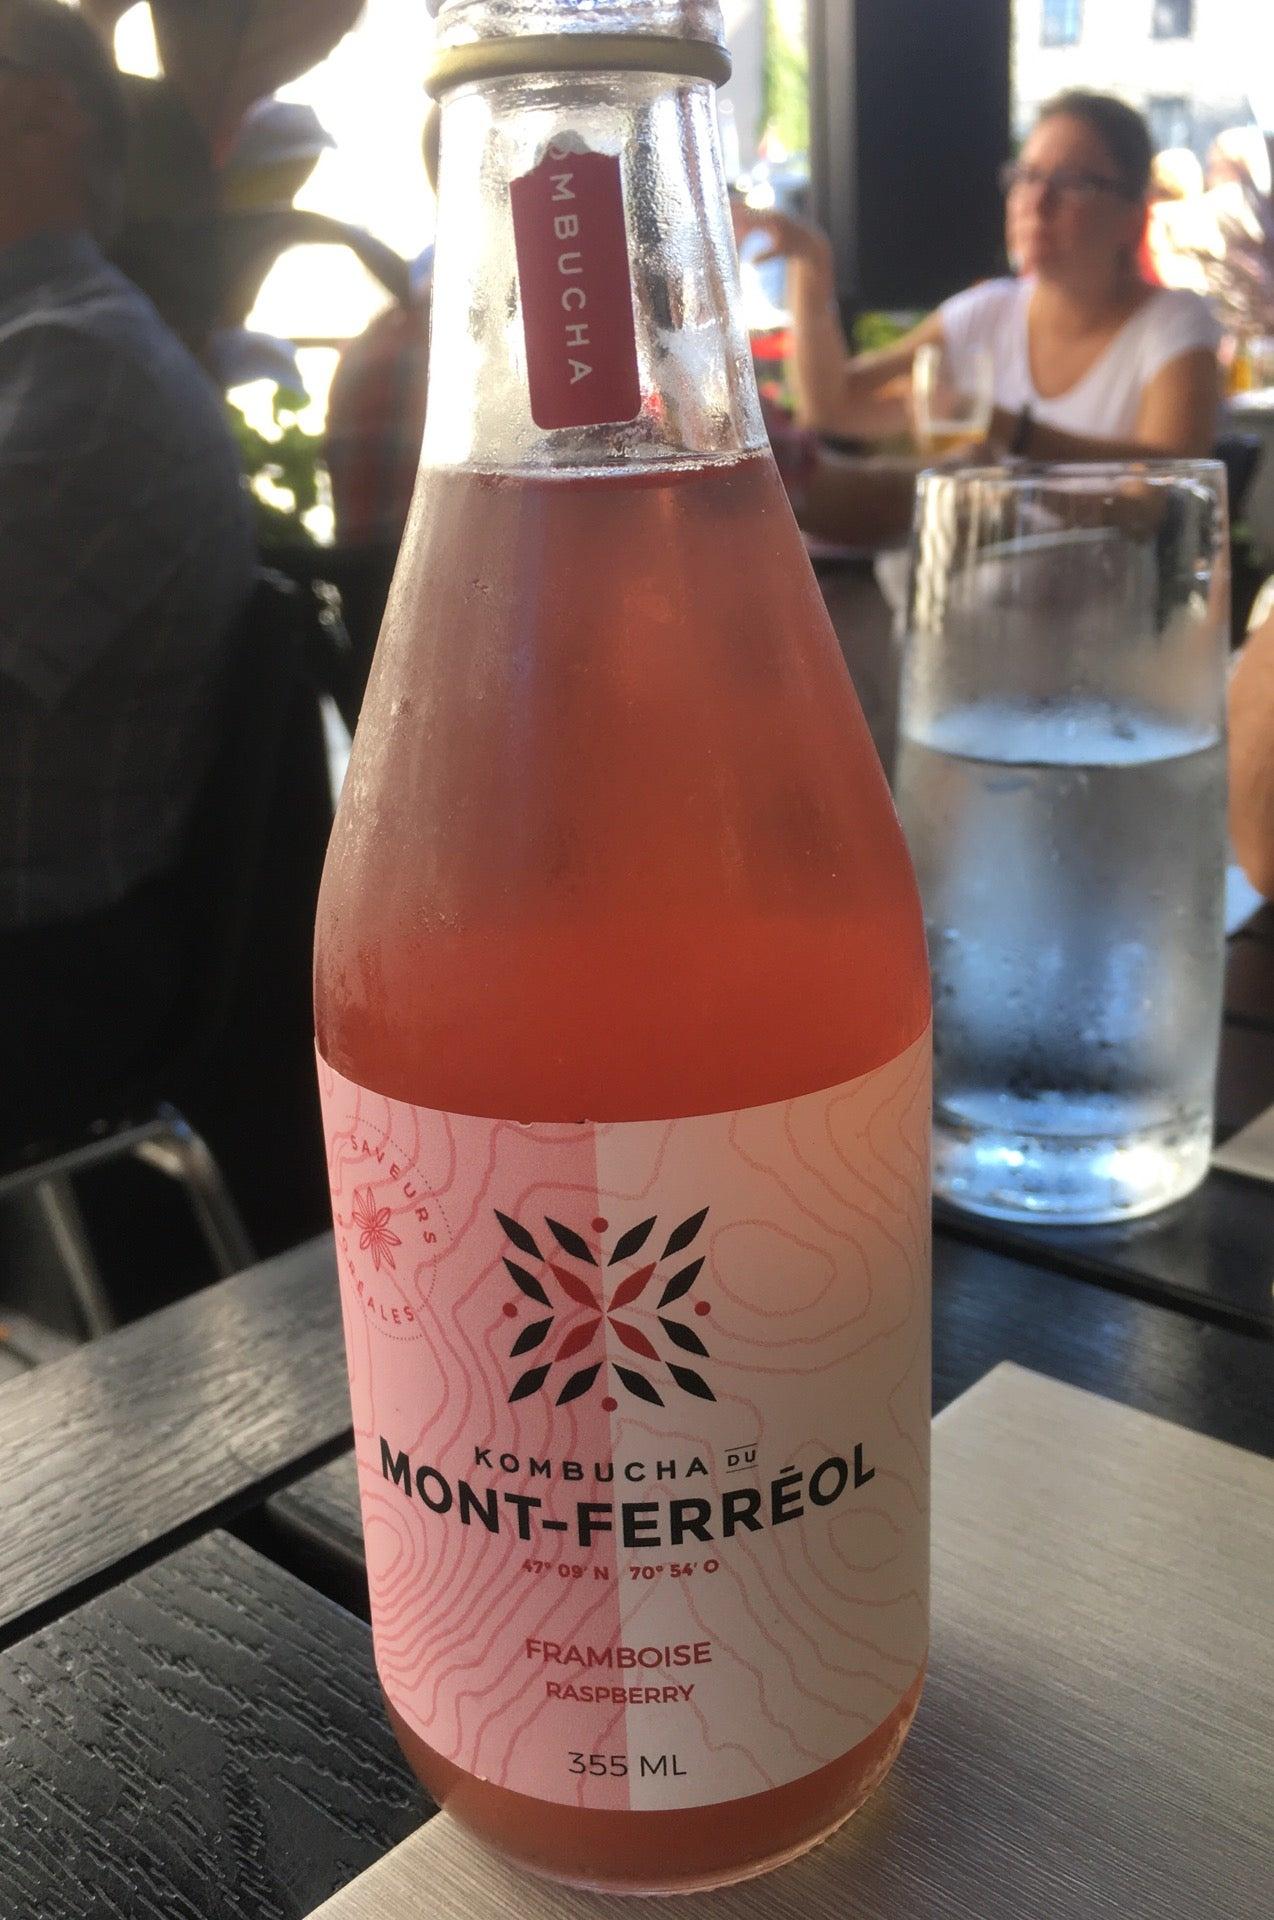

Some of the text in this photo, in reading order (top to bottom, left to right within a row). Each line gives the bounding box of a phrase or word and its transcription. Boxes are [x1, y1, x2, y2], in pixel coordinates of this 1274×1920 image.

[350, 1134, 437, 1244] SAVEURS
[474, 1446, 756, 1482] KOMBUCHA DU
[379, 1435, 875, 1548] MONT-FERRÉOL
[594, 1566, 609, 1580] N
[629, 1566, 663, 1581] 70°
[526, 1639, 712, 1668] FRAMBOISE
[547, 1682, 695, 1704] RASPBERRY
[568, 1752, 687, 1777] 355 ML
